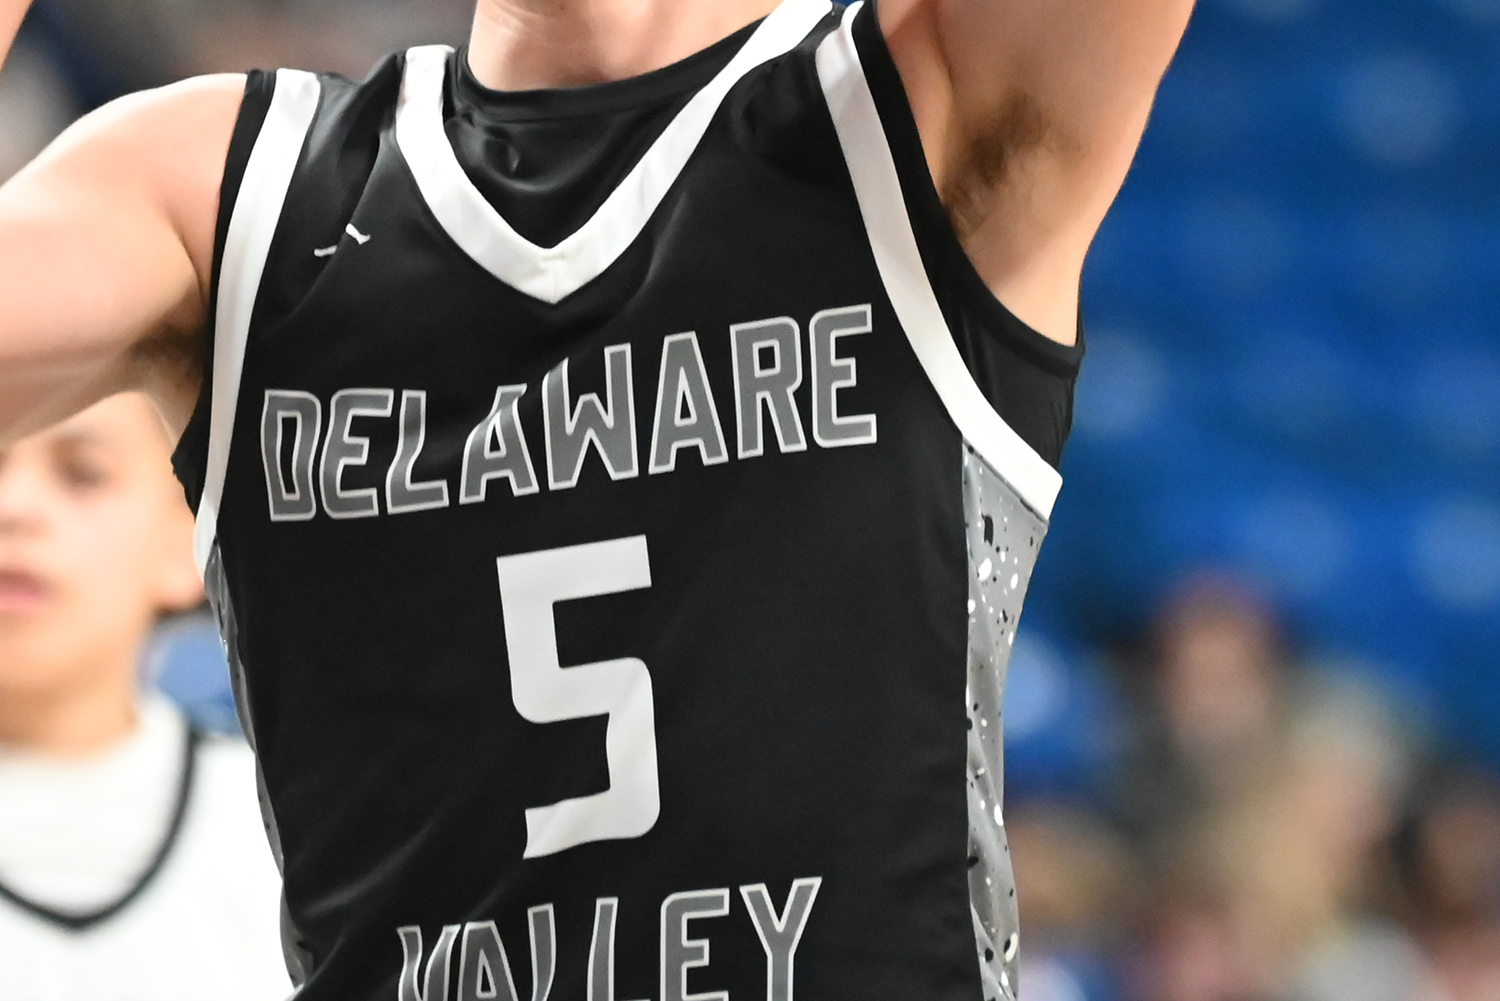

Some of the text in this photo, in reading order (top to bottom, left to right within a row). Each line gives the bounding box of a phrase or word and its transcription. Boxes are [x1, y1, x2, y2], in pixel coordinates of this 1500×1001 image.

[261, 304, 877, 521] DELAWARE
[497, 534, 661, 860] 5
[396, 876, 823, 1001] VALLEY
